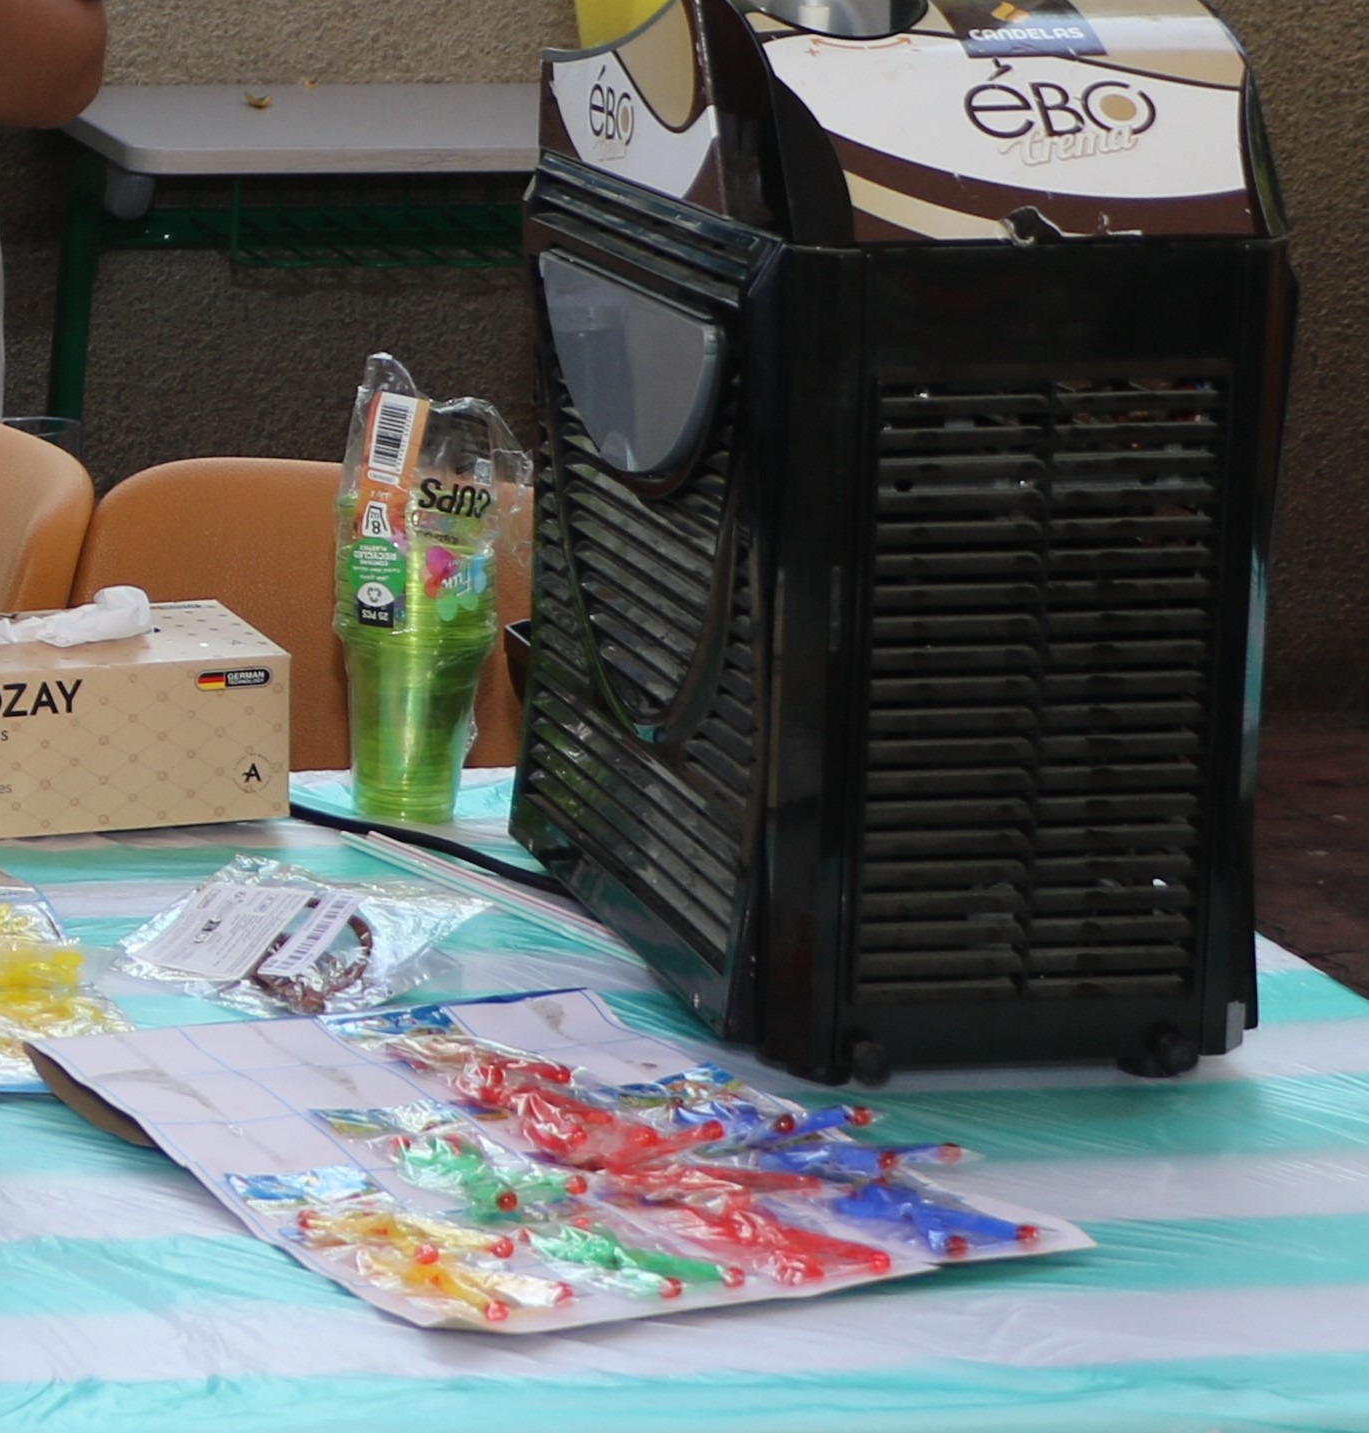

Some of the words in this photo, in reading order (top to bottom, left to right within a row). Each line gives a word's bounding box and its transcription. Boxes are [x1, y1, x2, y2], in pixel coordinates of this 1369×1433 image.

[968, 26, 1085, 42] CANDELAS
[417, 476, 492, 519] CUPS
[371, 520, 381, 535] 8
[227, 671, 265, 681] GERMAN
